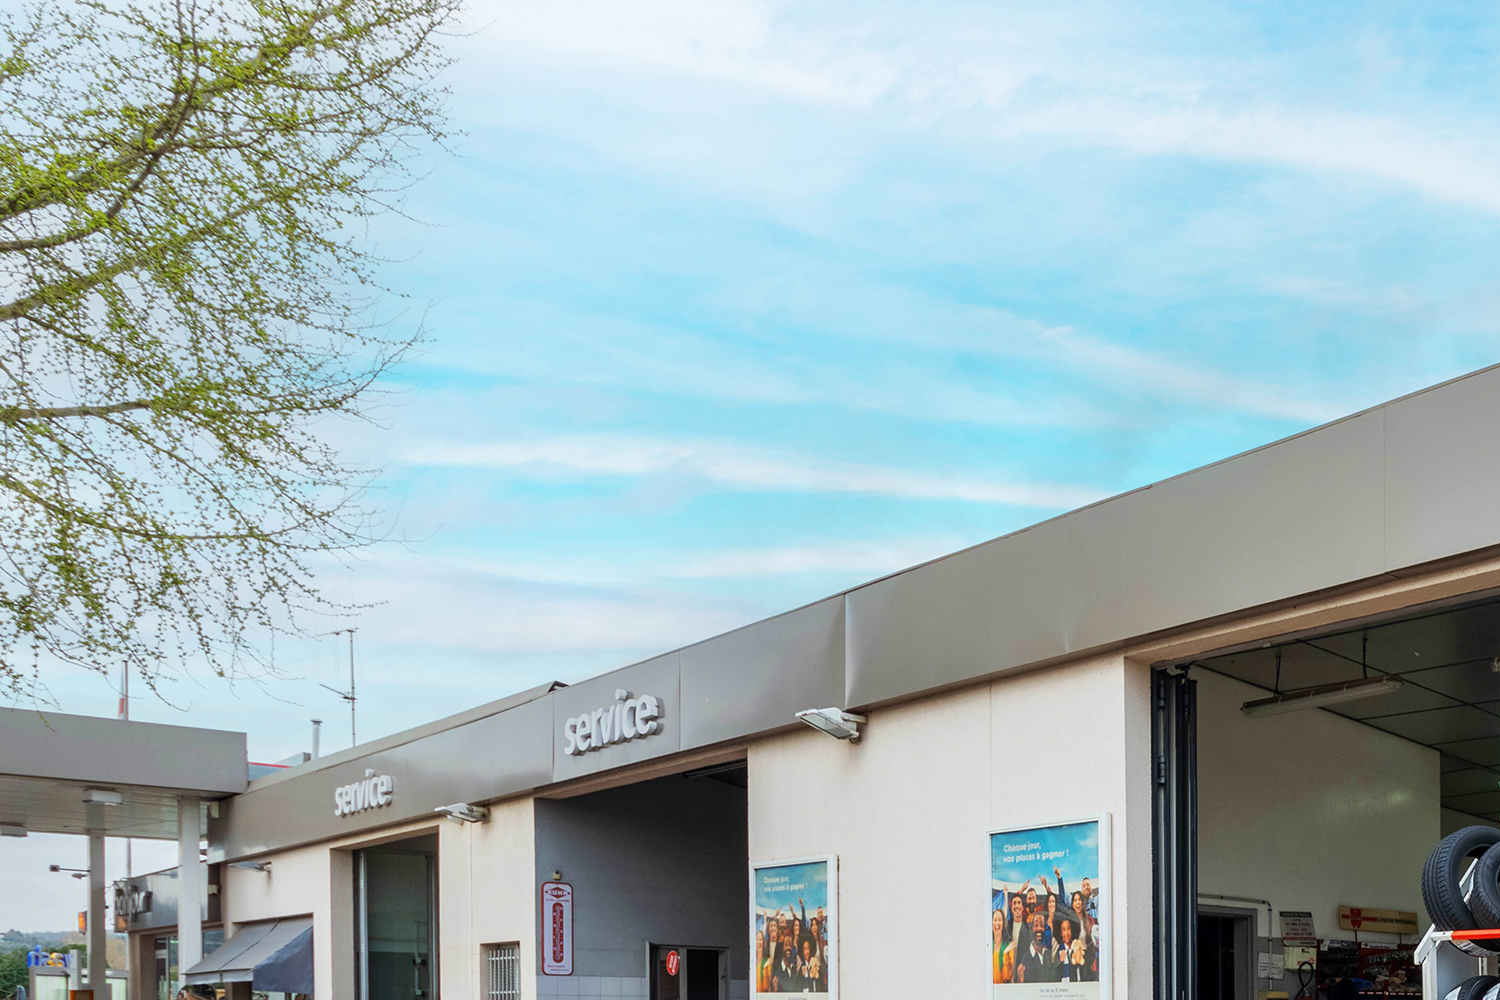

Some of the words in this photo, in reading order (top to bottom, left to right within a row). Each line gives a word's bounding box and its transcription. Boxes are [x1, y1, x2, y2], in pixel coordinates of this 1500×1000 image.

[564, 689, 662, 755] service
[334, 768, 393, 817] service
[1003, 843, 1026, 852] Chaque
[1027, 841, 1041, 851] jour,
[1003, 855, 1014, 863] vos
[1015, 853, 1035, 863] places
[1041, 849, 1065, 861] gagner
